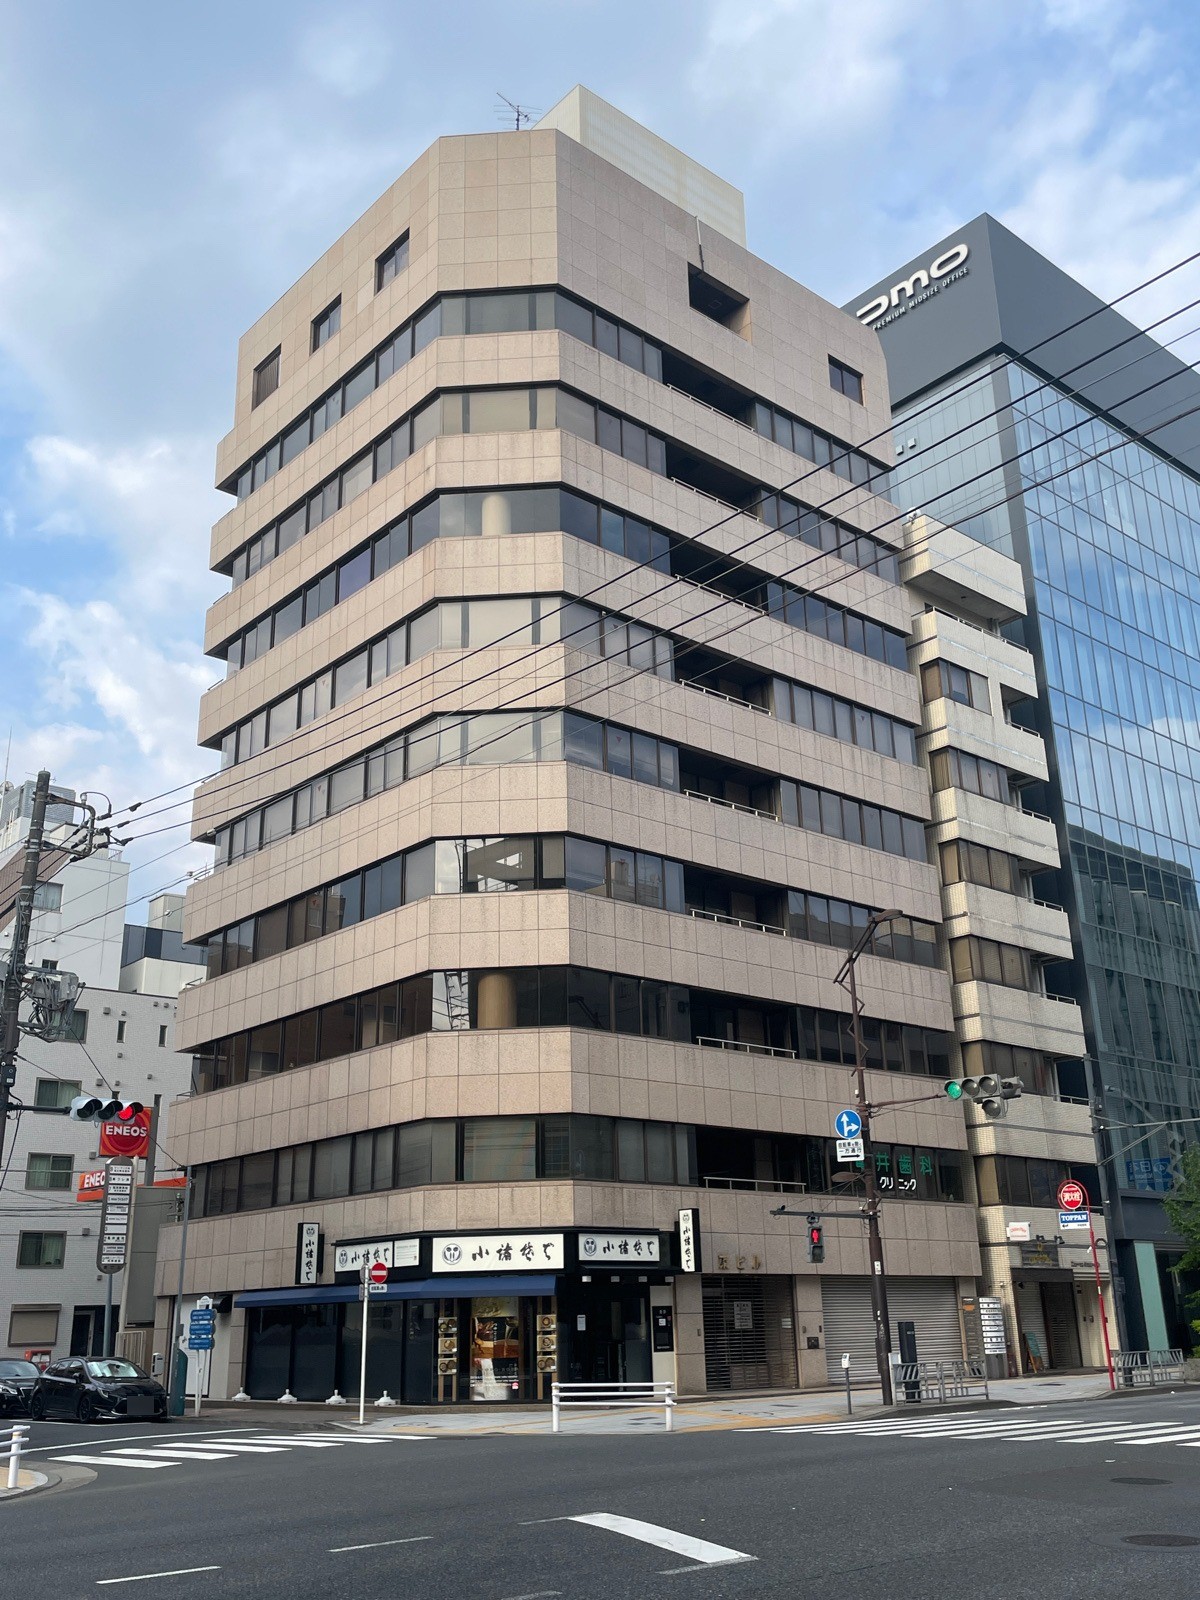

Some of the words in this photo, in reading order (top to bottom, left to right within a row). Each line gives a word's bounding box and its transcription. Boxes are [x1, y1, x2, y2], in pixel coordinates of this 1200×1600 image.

[872, 306, 907, 331] PREMIUM
[908, 285, 939, 309] MIDSIZE
[942, 266, 969, 287] OFFICE
[105, 1124, 147, 1137] ENEOS
[879, 1176, 917, 1191] クリニック
[1062, 1191, 1081, 1202] 消火栓
